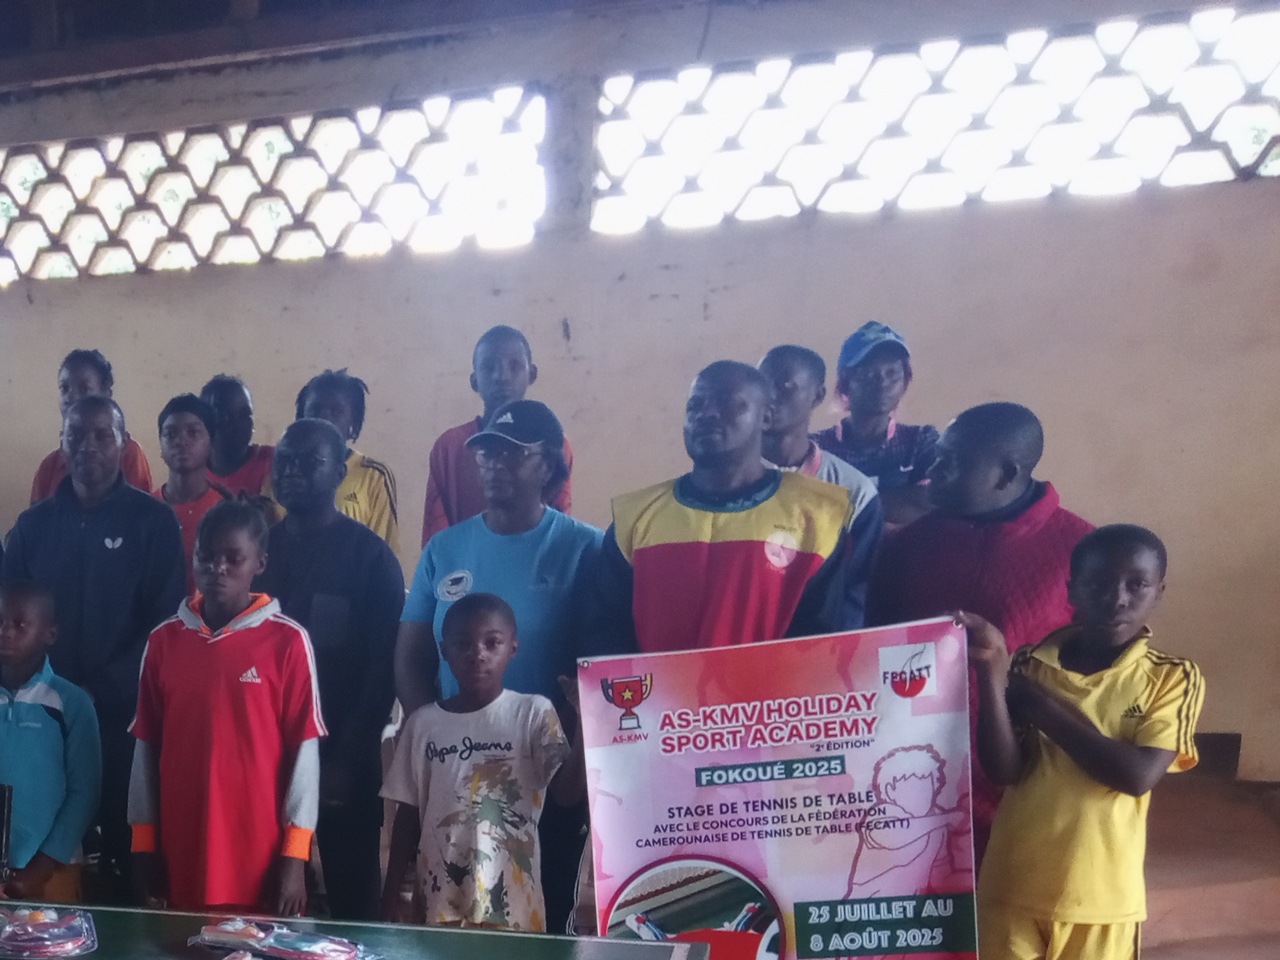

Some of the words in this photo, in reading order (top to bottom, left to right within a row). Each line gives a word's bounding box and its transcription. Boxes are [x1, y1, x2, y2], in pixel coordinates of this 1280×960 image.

[659, 704, 759, 731] AS-KMV
[766, 692, 877, 720] HOLIDAY
[612, 733, 648, 743] AS-KMV
[661, 729, 743, 754] SPORT
[750, 717, 878, 746] ACADEMY
[426, 741, 458, 763] Pepe
[460, 736, 513, 760] Jeans
[700, 761, 785, 785] FOKOUÉ
[792, 760, 842, 777] 2025
[667, 804, 714, 819] STAGE
[720, 802, 738, 815] DE
[743, 797, 797, 813] TENNIS
[803, 795, 822, 808] DE
[827, 790, 873, 806] TABLE
[635, 832, 728, 848] CAMEROUNAISE
[731, 831, 747, 841] DE
[749, 827, 793, 840] TENNIS
[795, 826, 812, 837] DE
[814, 822, 852, 835] TABLE
[855, 819, 910, 832] (FECATT)
[653, 823, 684, 834] AVEC
[686, 821, 699, 831] LE
[702, 816, 769, 830] CONCOURS
[772, 814, 787, 825] DE
[790, 813, 805, 823] LA
[808, 806, 886, 822] FÉDÉRATION
[808, 905, 830, 924] 25
[834, 900, 916, 922] JUILLET
[921, 898, 953, 917] AU
[810, 934, 824, 951] 8
[828, 927, 891, 950] AOÛT
[896, 928, 943, 947] 2025
